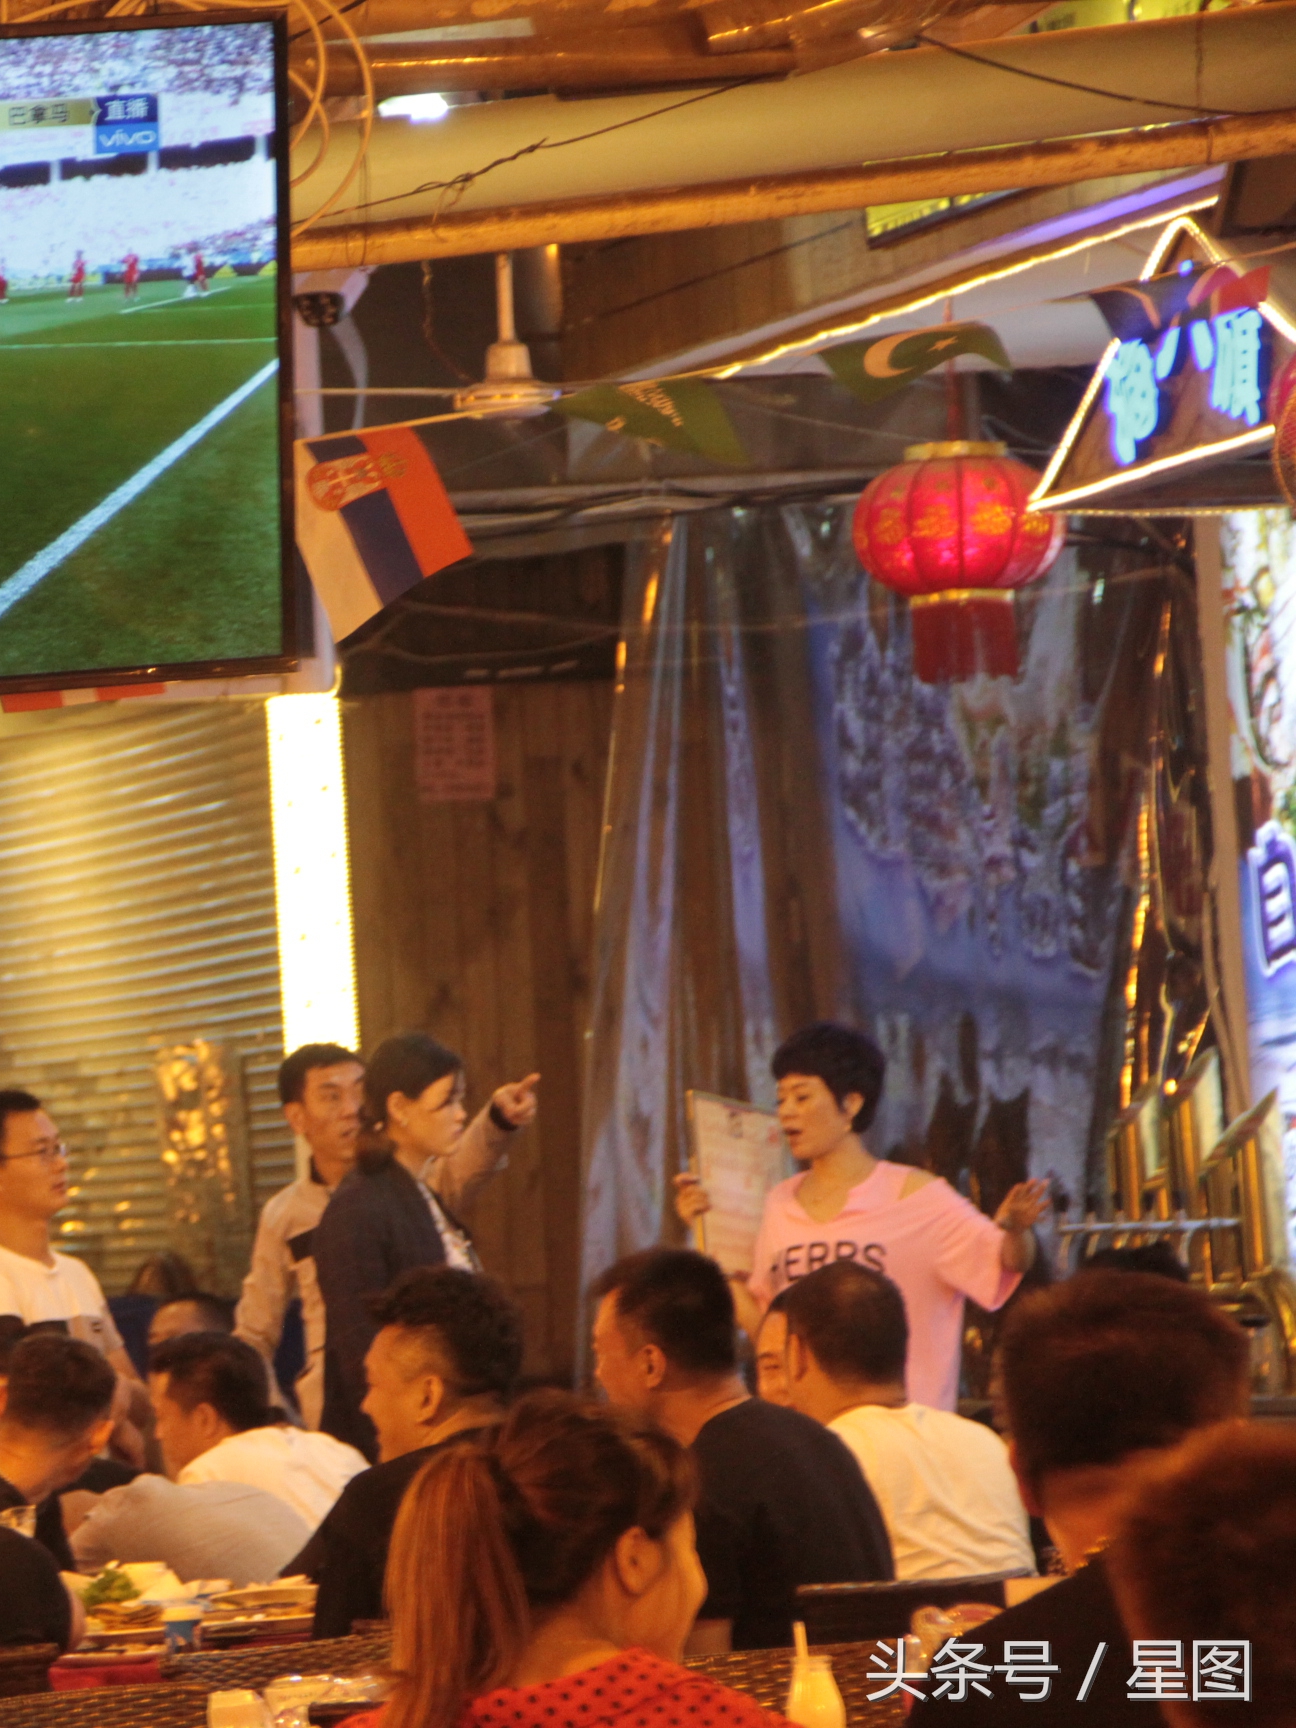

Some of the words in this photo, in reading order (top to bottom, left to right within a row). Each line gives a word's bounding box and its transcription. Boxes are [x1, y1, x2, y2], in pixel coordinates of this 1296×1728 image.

[7, 103, 70, 125] 巴拿马
[104, 97, 150, 120] 直播
